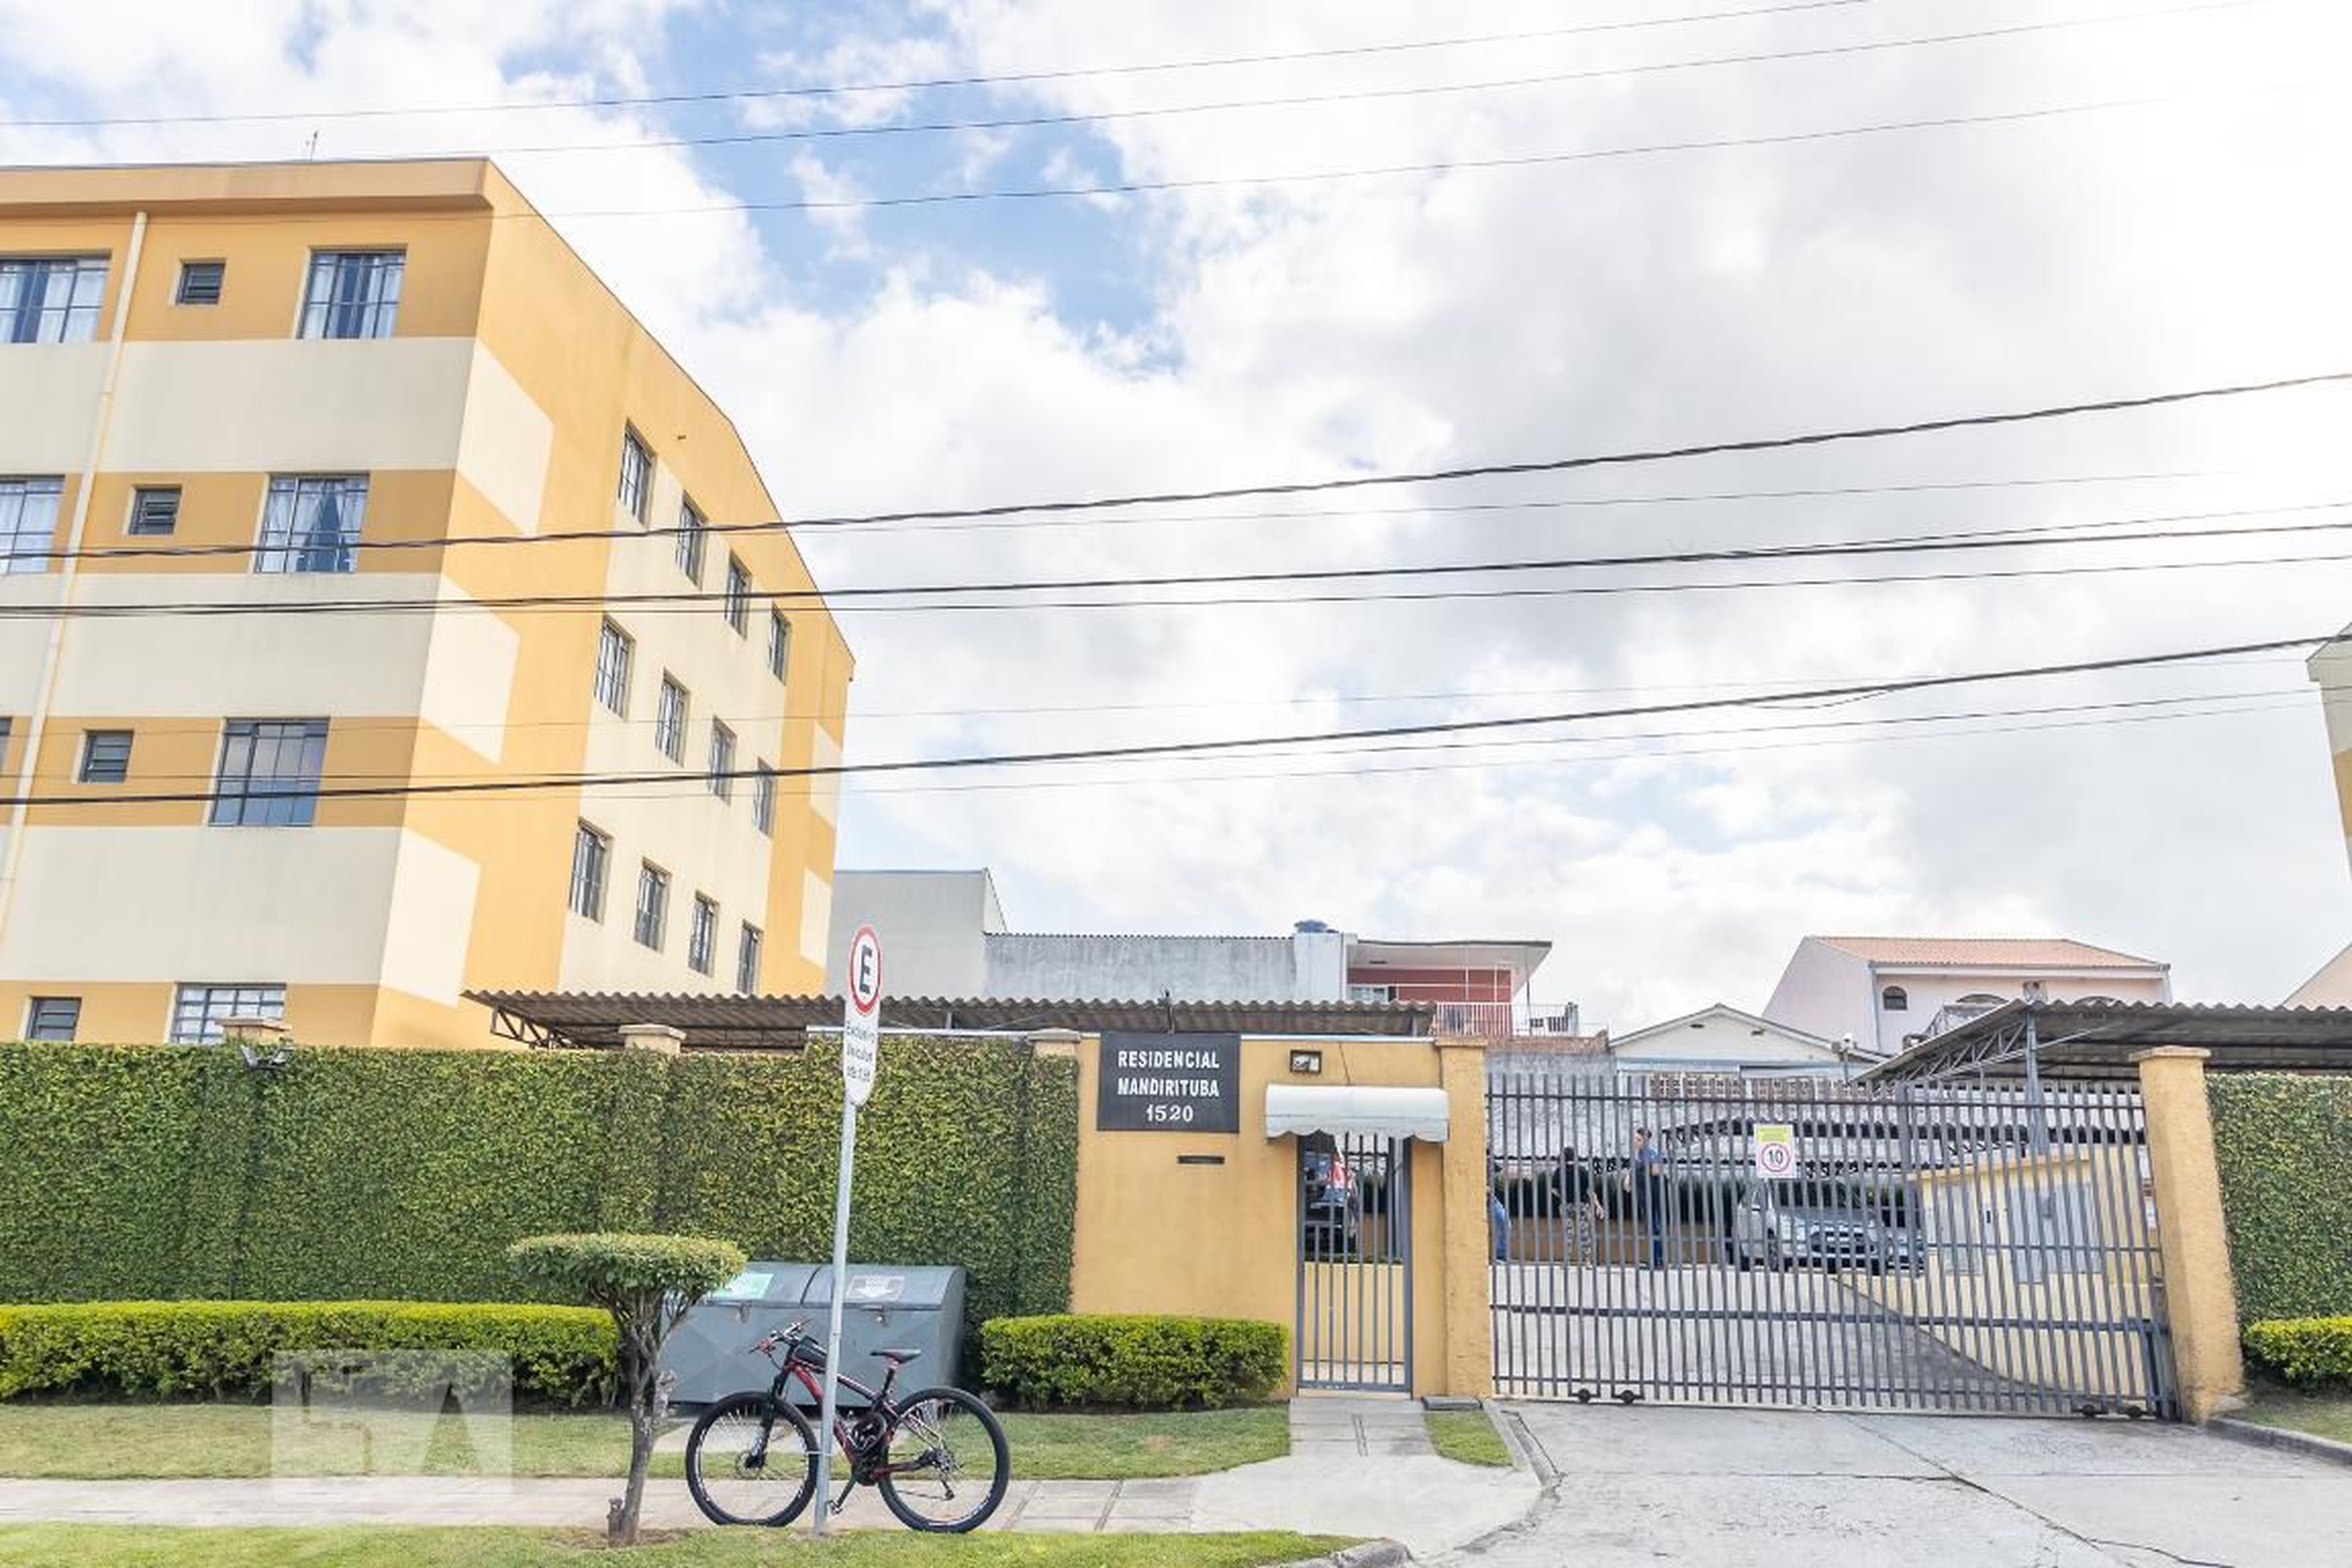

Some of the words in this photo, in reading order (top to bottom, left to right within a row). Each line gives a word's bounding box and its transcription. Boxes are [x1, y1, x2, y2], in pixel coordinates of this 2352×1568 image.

[859, 944, 872, 994] E
[1118, 1050, 1219, 1068] RESIDENCIAL
[1118, 1078, 1219, 1097] MANDIRITUBA
[1146, 1104, 1194, 1122] 1520
[1768, 1150, 1783, 1164] 10
